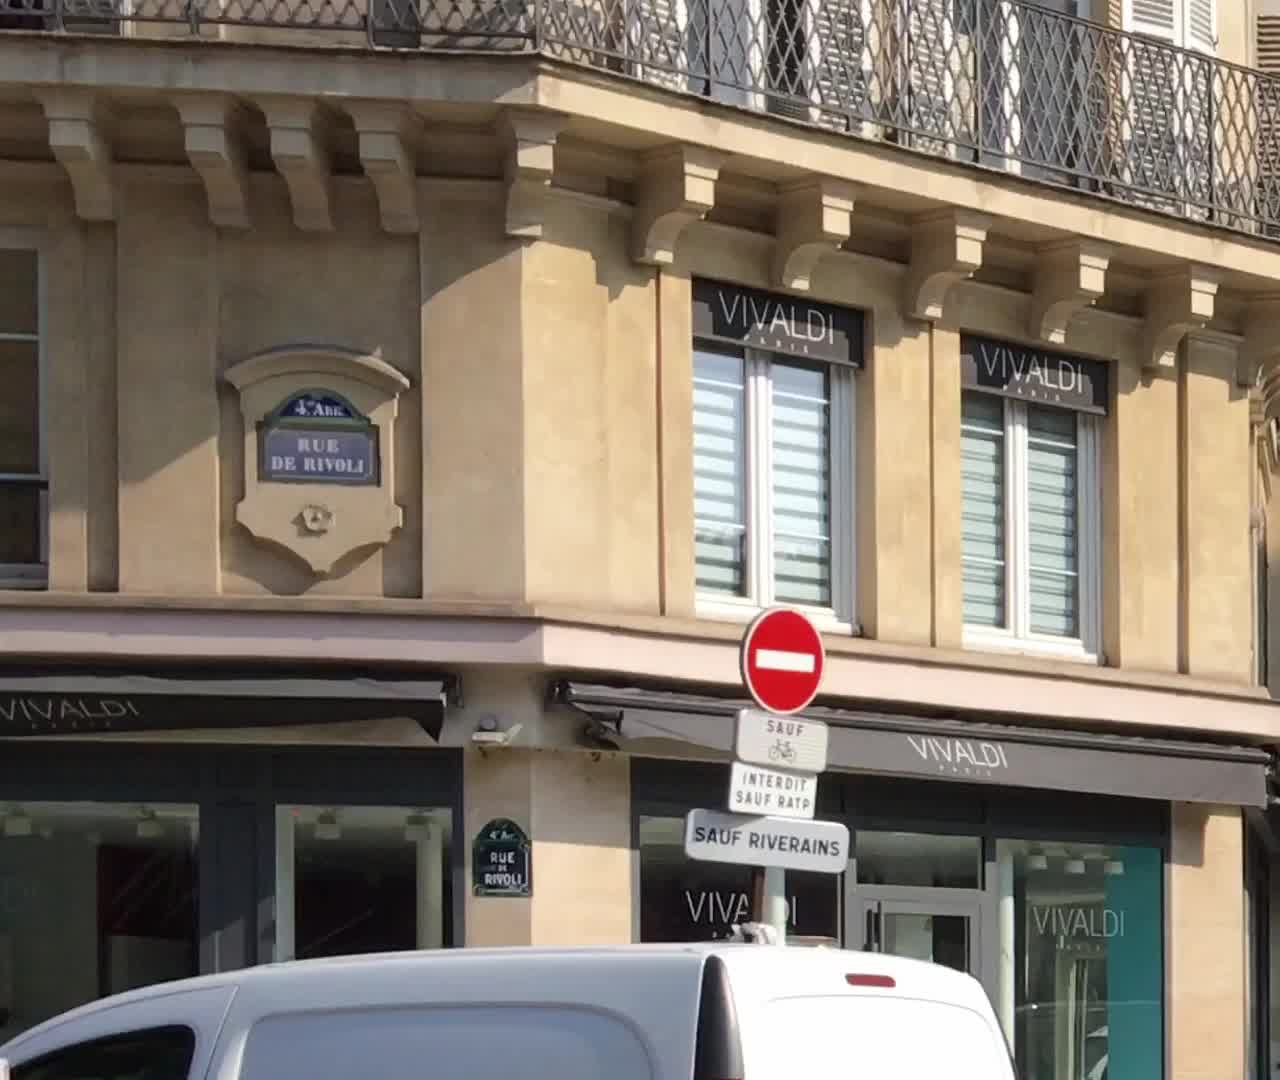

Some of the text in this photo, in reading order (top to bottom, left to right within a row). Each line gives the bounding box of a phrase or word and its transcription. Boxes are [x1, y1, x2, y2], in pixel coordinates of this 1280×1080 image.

[718, 290, 834, 345] VIVALDI
[980, 343, 1083, 393] VIVALDI
[297, 438, 340, 453] RUE
[271, 456, 364, 473] DE RIVOLI
[767, 719, 805, 737] SAUF
[906, 735, 1009, 768] VIVALDI
[743, 772, 808, 792] INTERDIT
[736, 790, 810, 810] SAUF RATP
[695, 826, 840, 857] SAUF RIVERAINS
[490, 852, 515, 863] RUE
[484, 873, 522, 885] RIVOLI
[1032, 906, 1125, 937] VIVALDI
